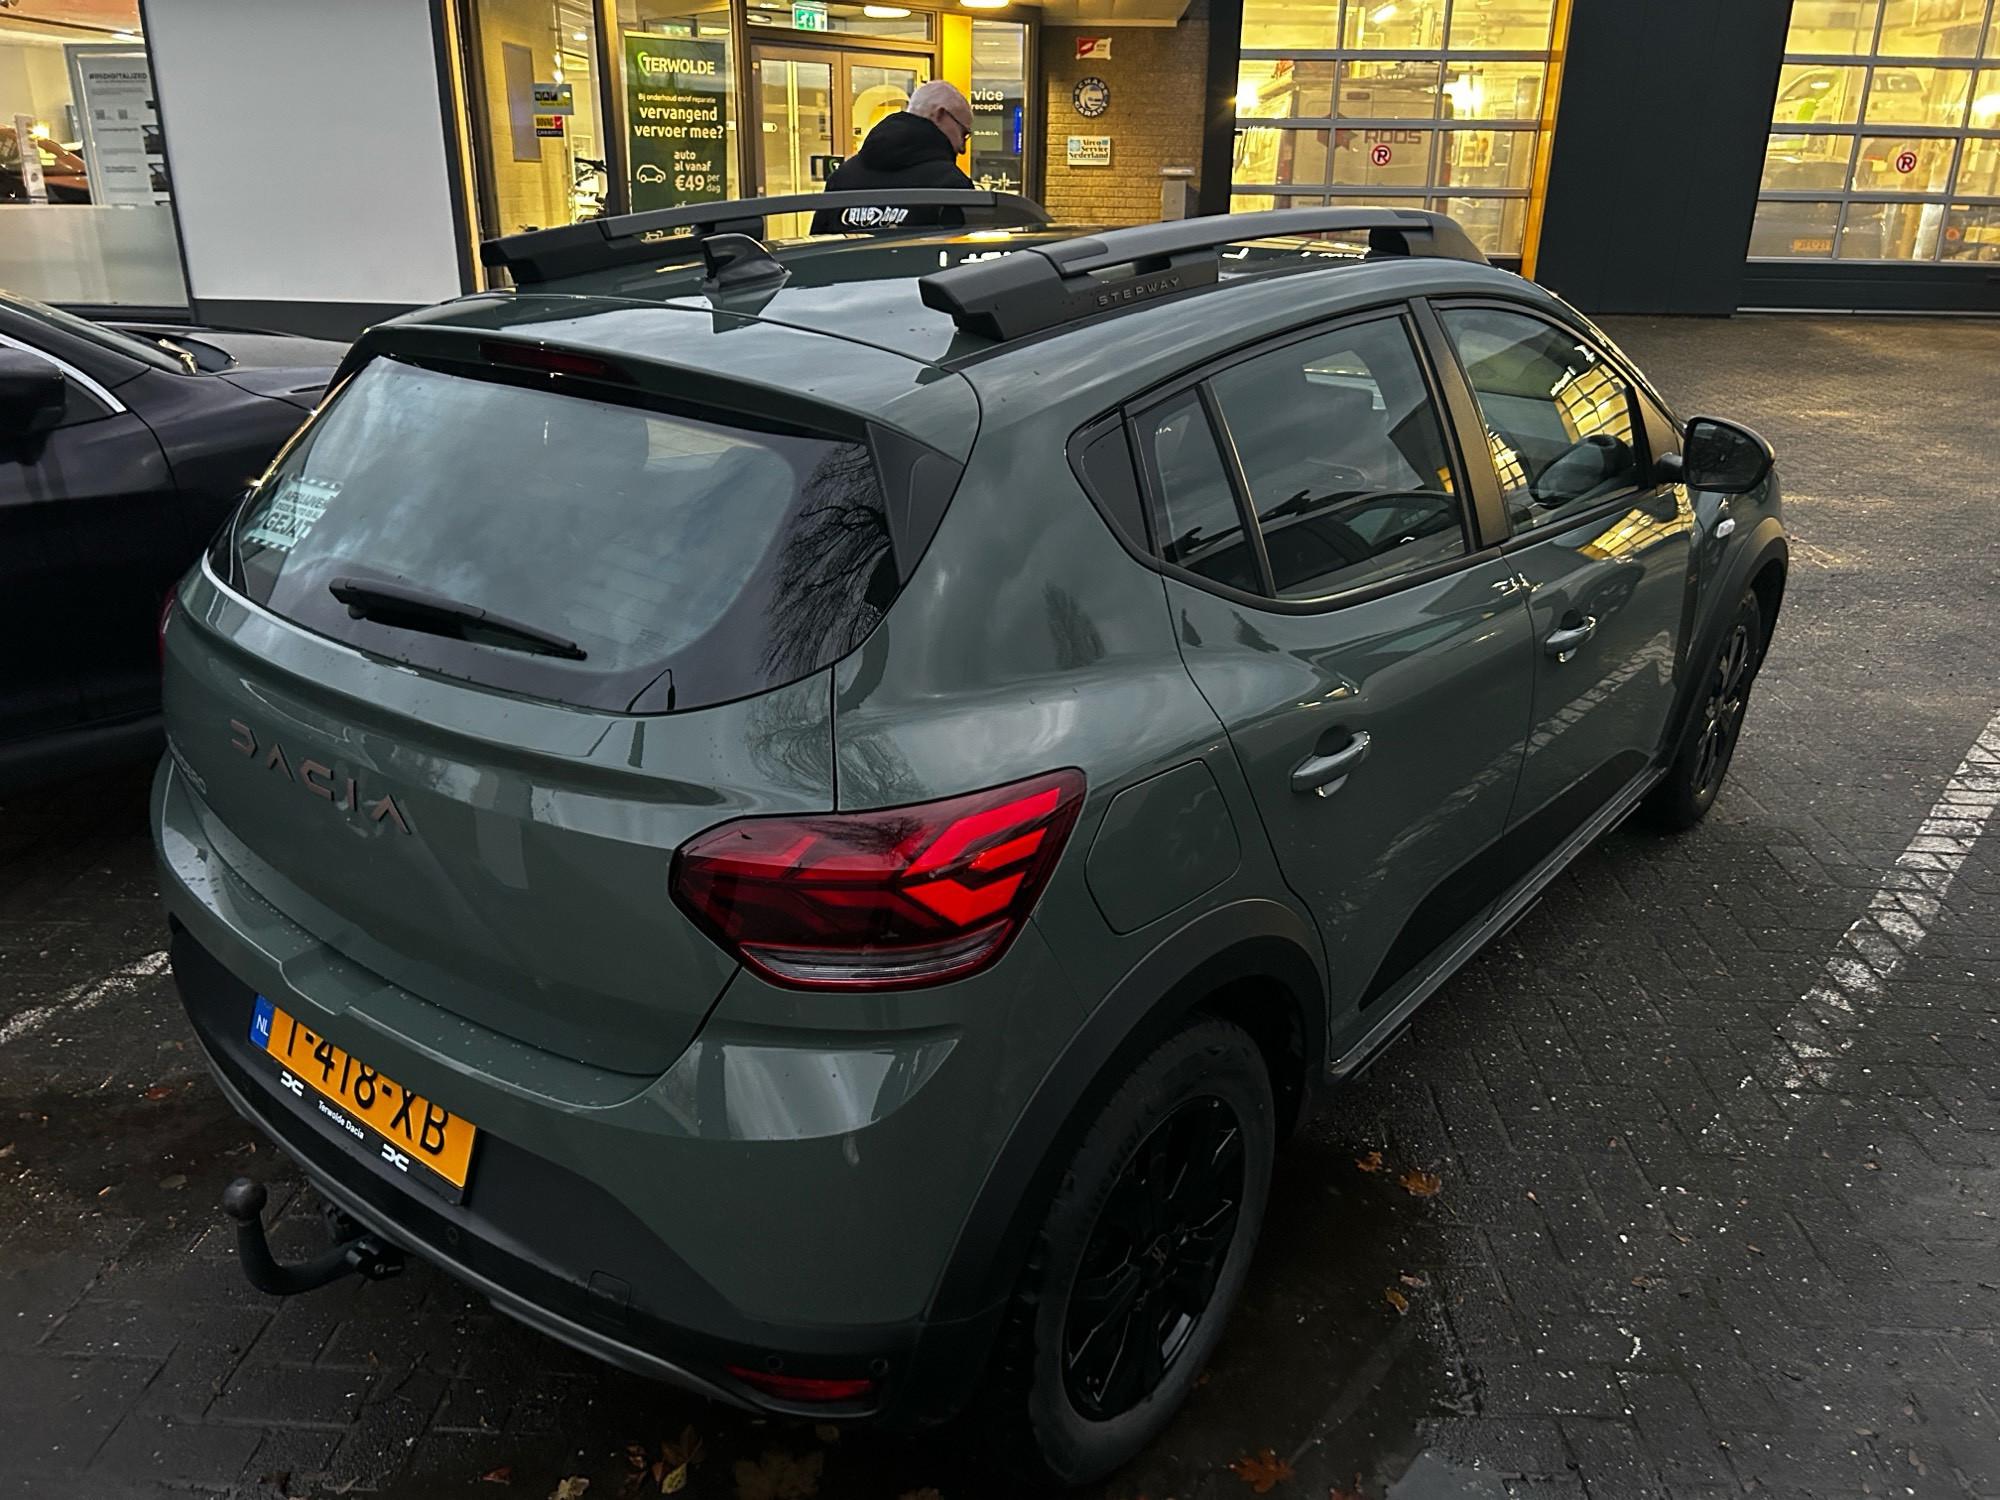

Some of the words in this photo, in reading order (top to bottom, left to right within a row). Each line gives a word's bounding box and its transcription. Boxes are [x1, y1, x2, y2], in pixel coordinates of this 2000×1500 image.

[643, 56, 716, 75] TERWOLDE
[646, 94, 677, 102] onderhoud
[971, 87, 1004, 101] vice
[639, 107, 718, 124] vervangend
[634, 125, 687, 139] vervoer
[690, 125, 724, 139] mee?
[1364, 130, 1421, 144] ROOS
[673, 150, 696, 160] auto
[674, 161, 683, 171] al
[685, 161, 712, 172] vanaf
[675, 174, 705, 192] €49
[706, 174, 720, 183] per
[706, 183, 721, 194] dag
[1098, 276, 1181, 307] STEPWAY
[230, 718, 412, 835] DACIA
[256, 1014, 269, 1037] NL
[318, 1099, 345, 1126] Terwolde
[345, 1120, 364, 1140] Dacia
